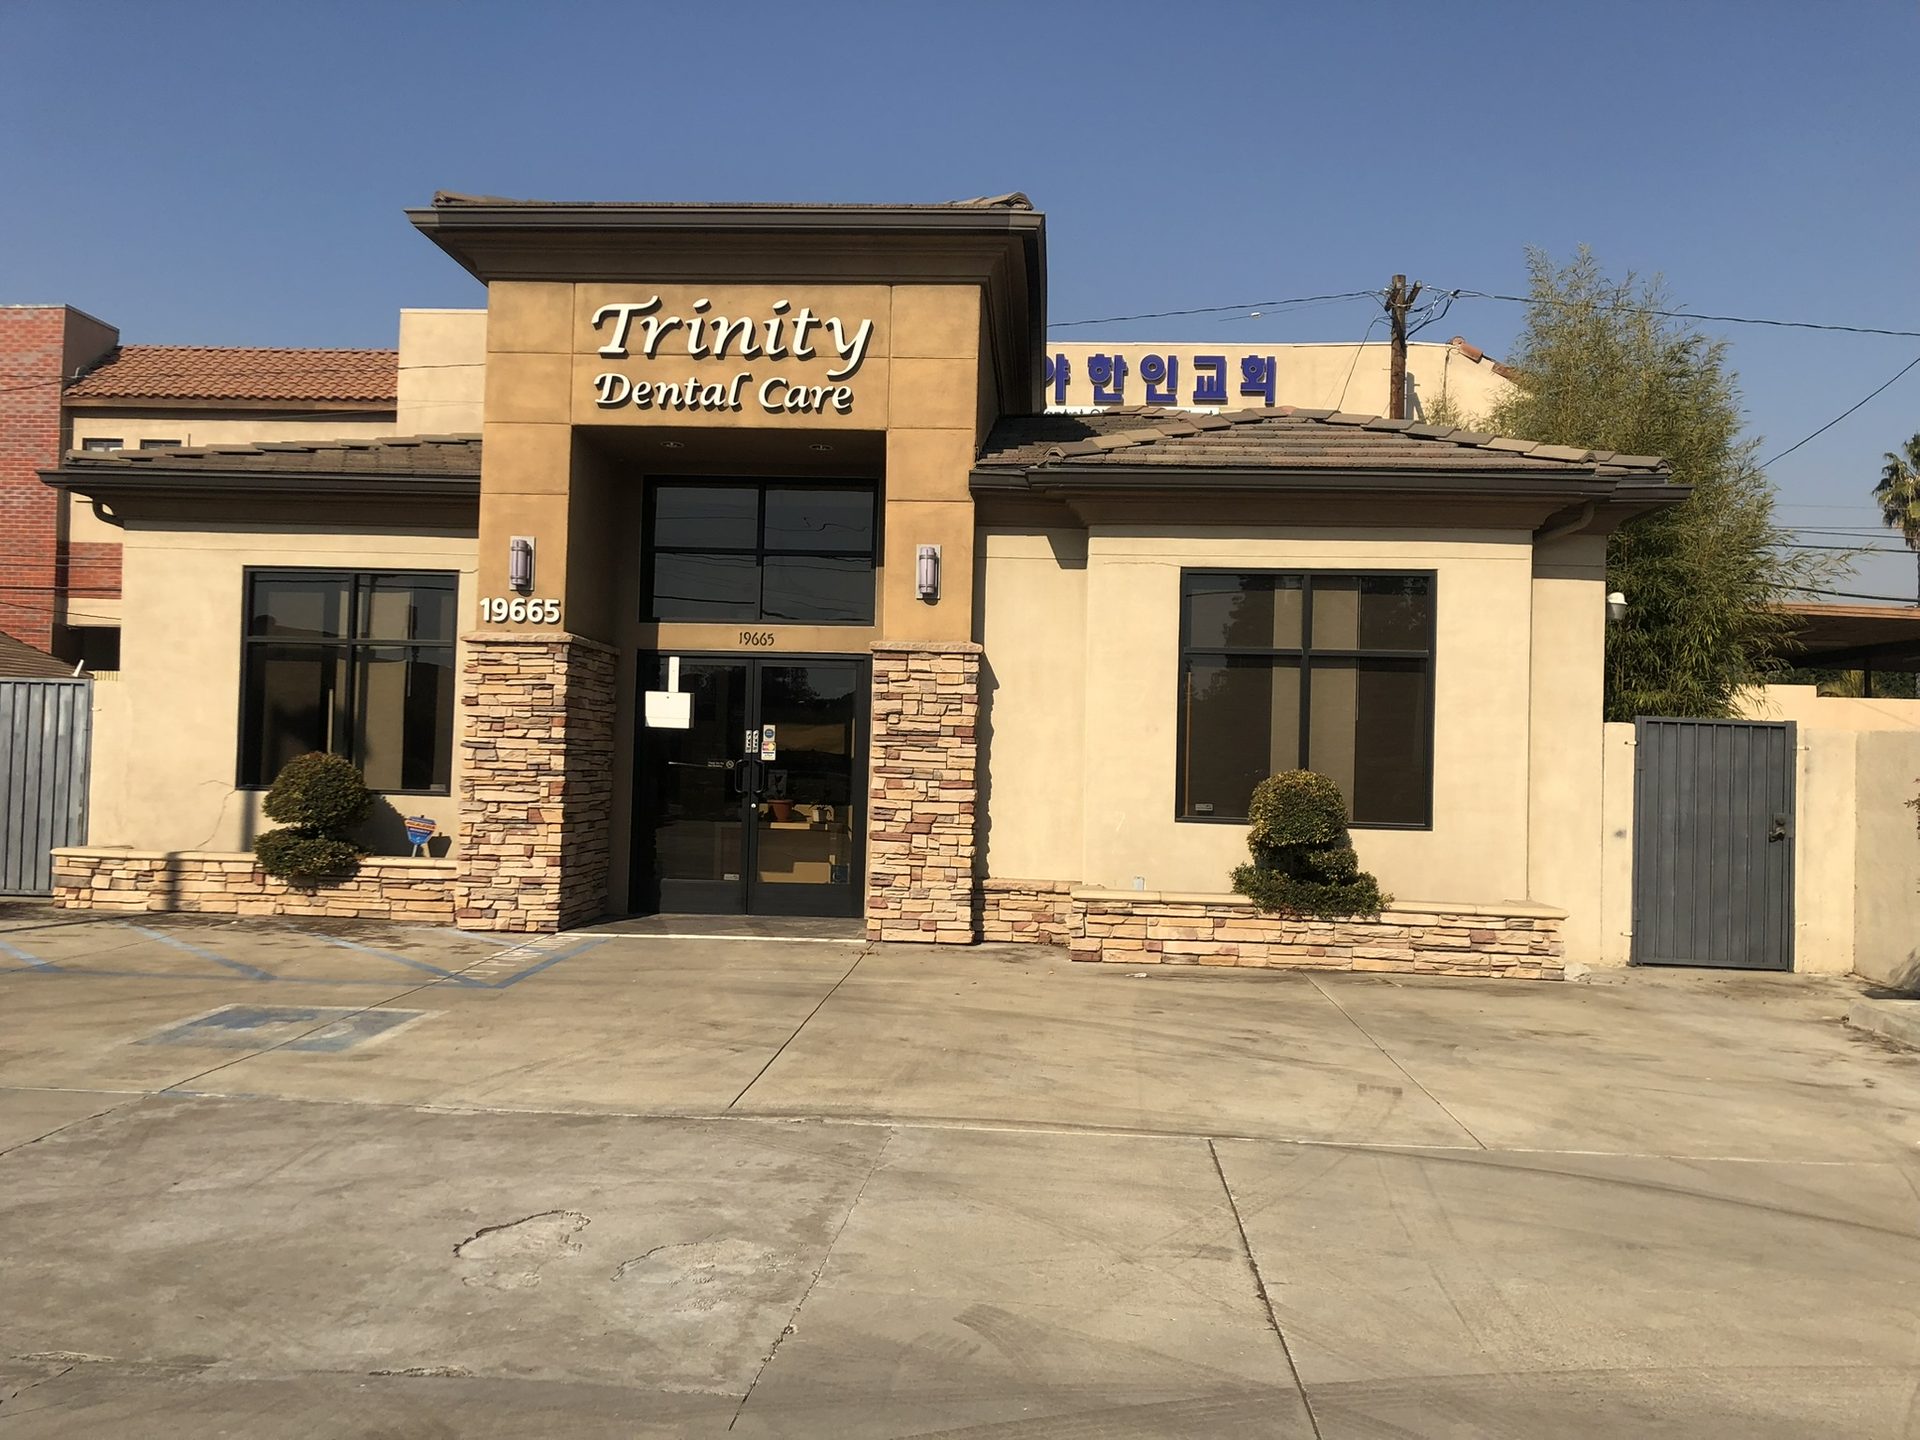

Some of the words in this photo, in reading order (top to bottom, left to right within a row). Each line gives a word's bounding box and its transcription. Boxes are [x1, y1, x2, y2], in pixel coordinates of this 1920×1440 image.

[590, 295, 873, 379] Trinity
[593, 372, 751, 409] Dental
[758, 376, 853, 411] Care
[480, 597, 561, 623] 19665
[738, 631, 775, 647] 19665
